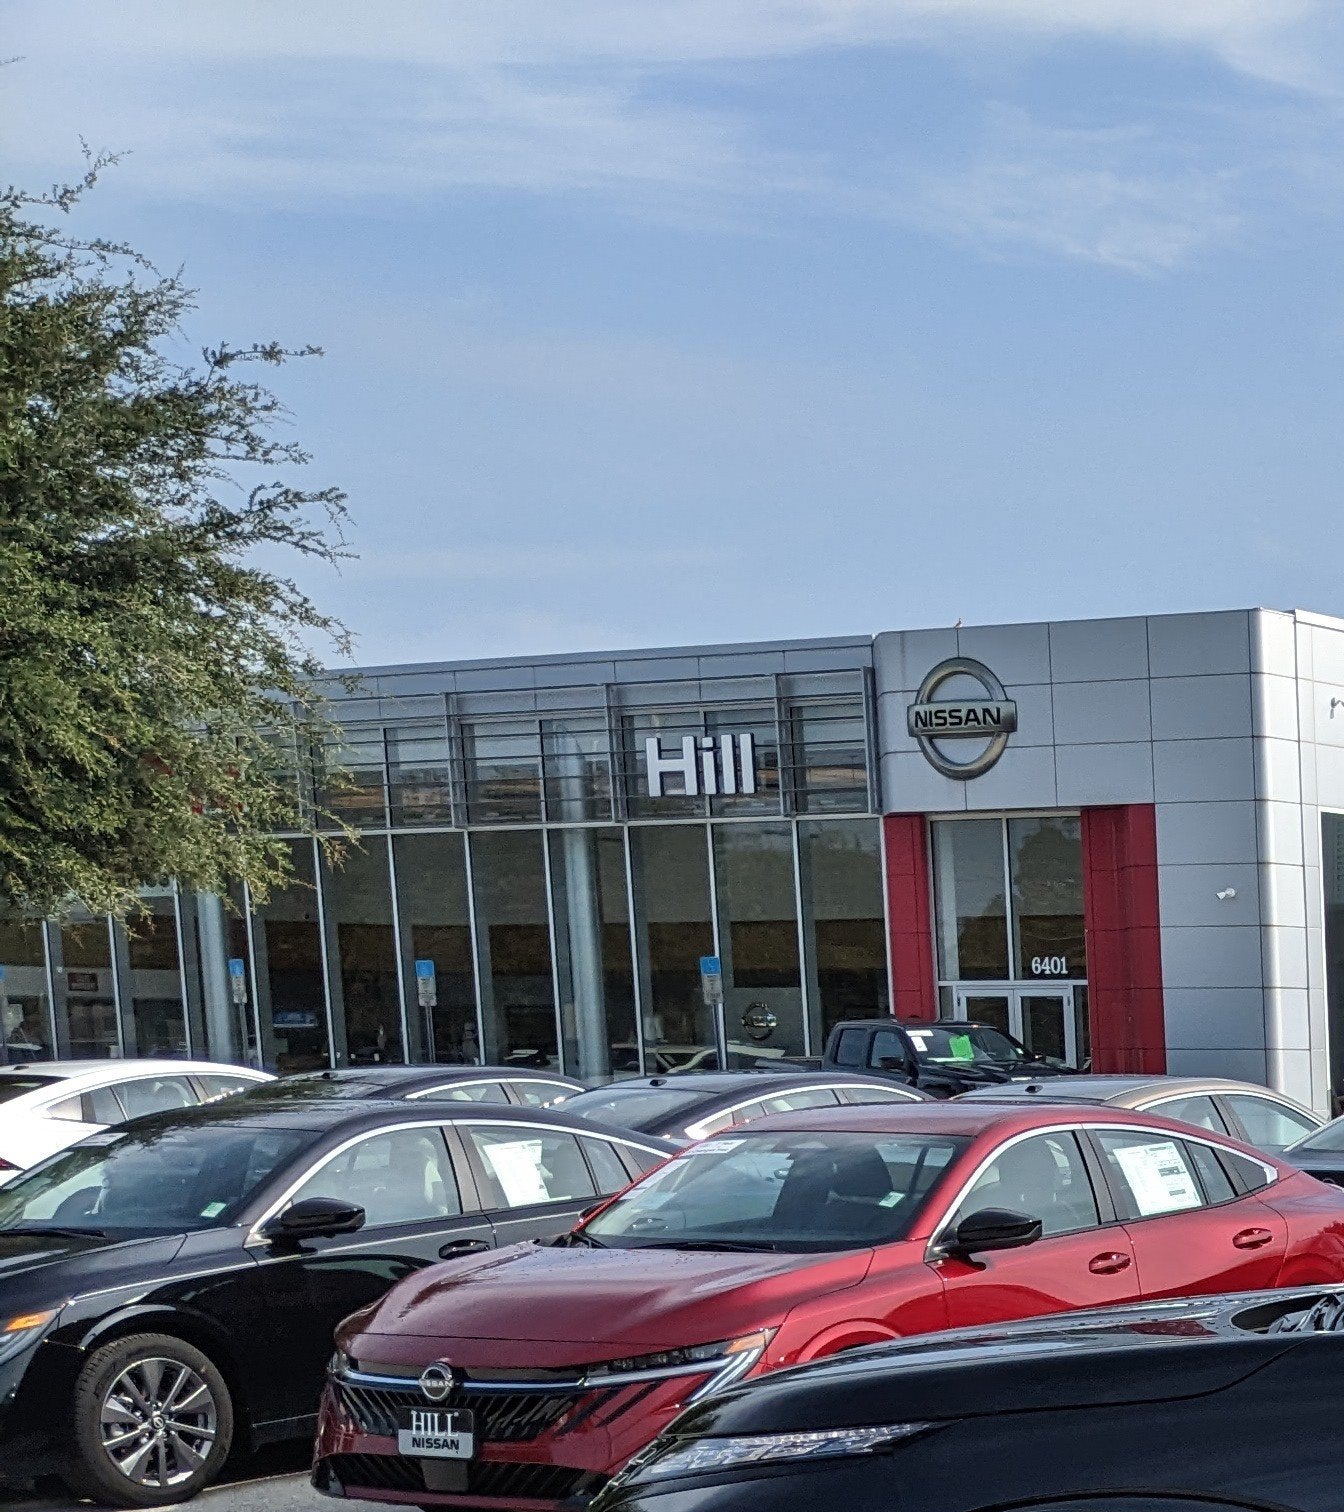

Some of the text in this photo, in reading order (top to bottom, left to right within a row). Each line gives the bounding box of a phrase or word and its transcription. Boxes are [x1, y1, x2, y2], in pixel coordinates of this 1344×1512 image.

[914, 706, 1001, 729] NISSAN
[645, 733, 756, 797] Hill
[1031, 956, 1069, 975] 6401
[411, 1410, 459, 1437] HILL
[411, 1437, 459, 1450] NISSAN
